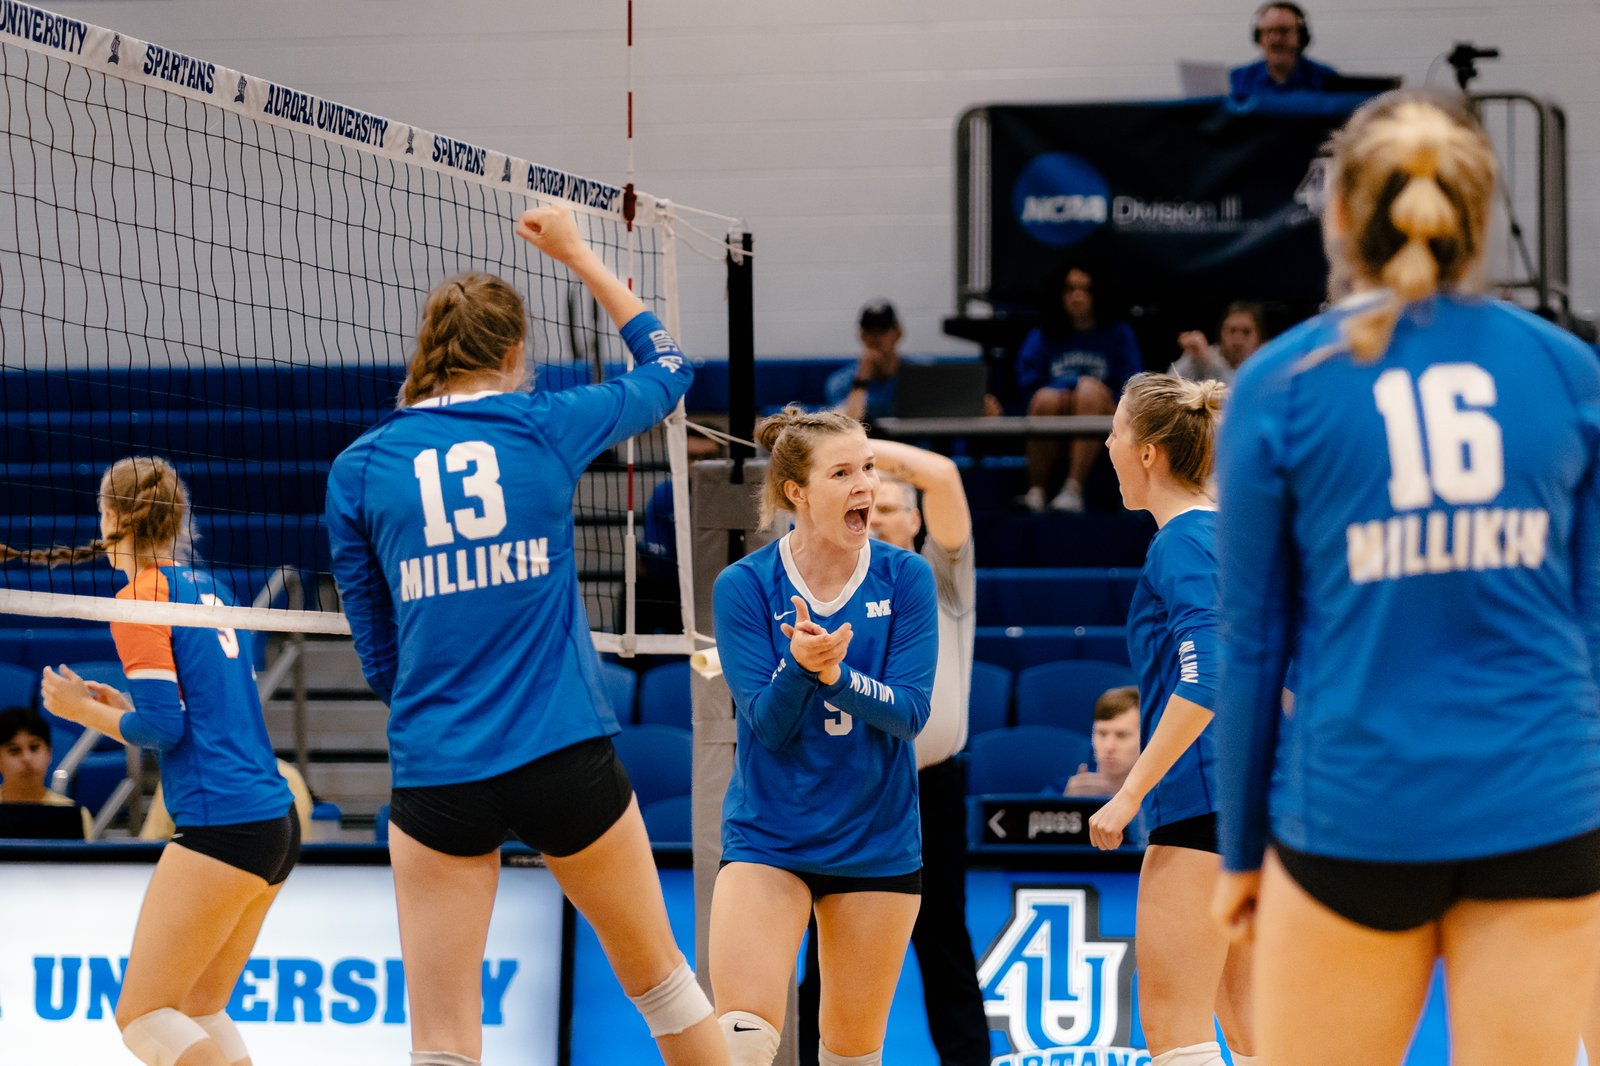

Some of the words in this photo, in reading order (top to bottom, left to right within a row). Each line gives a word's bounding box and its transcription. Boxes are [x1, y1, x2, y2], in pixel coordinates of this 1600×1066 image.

[144, 43, 216, 94] SPARTANS
[264, 84, 315, 127] AURORA
[317, 100, 389, 148] UNIVERSITY
[432, 134, 487, 176] SPARTANS
[1373, 362, 1505, 511] 16
[413, 441, 507, 547] 13
[400, 537, 550, 602] MILLIKIN
[865, 599, 892, 618] M
[33, 956, 519, 1025] UNERSIY
